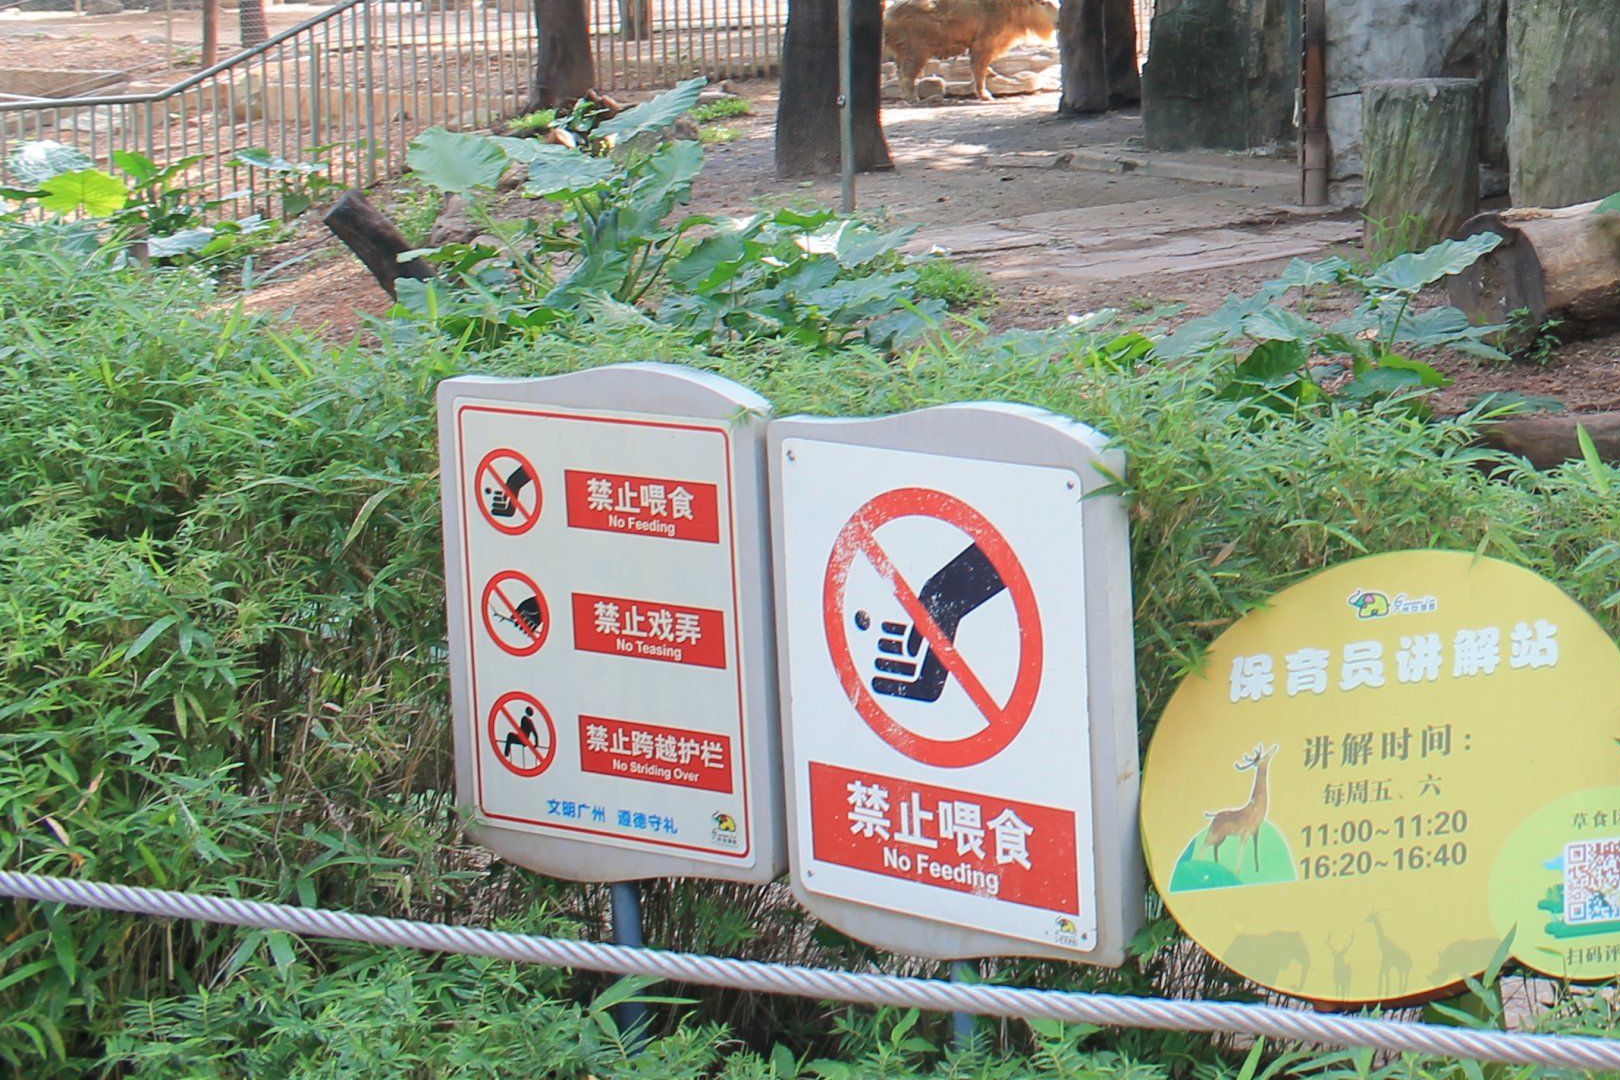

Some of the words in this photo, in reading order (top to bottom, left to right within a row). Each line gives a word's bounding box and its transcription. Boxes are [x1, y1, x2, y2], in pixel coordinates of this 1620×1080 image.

[587, 477, 694, 520] 禁止喂食
[608, 514, 626, 528] No
[628, 517, 676, 537] Feeding
[594, 601, 702, 645] 禁止戏弄
[616, 637, 634, 652] No
[635, 640, 683, 661] Teasing
[1229, 619, 1559, 702] 保育员讲解站
[586, 723, 725, 769] 禁止跨越护栏
[612, 758, 628, 771] No
[630, 761, 671, 780] Striding
[674, 769, 700, 782] Over
[1322, 773, 1443, 807] 每周五、六
[547, 798, 606, 823] 文明广州
[618, 809, 678, 835] 遵德守礼
[847, 780, 1034, 870] 禁止喂食
[1301, 809, 1468, 848] 11:00~11:20
[883, 846, 911, 871] No
[917, 853, 1000, 895] Feeding
[1300, 841, 1467, 880] 16:20~16:40
